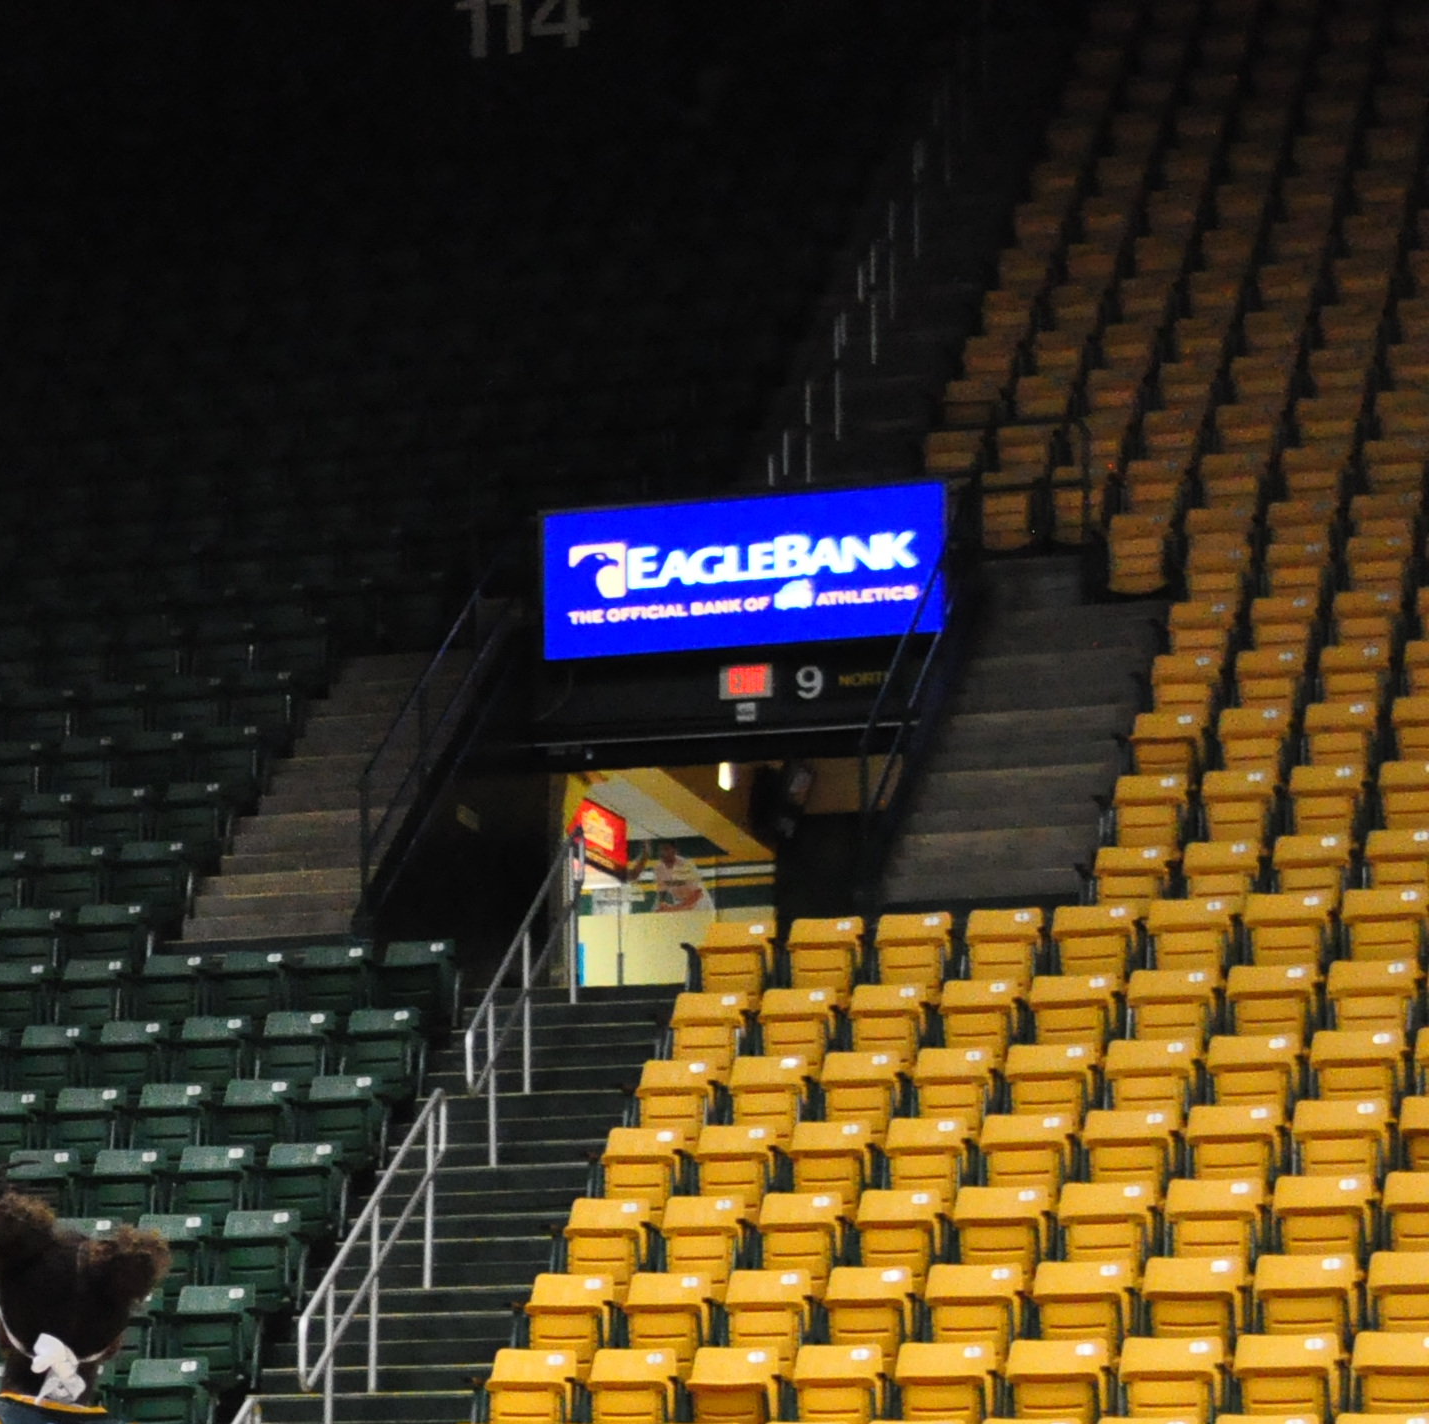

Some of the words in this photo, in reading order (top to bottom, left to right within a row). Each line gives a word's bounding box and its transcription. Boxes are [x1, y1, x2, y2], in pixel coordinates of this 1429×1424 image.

[627, 530, 919, 589] EAGLEBANK
[569, 610, 604, 624] THE
[606, 603, 688, 622] OFFICIAL
[691, 598, 741, 616] BANK
[744, 596, 769, 611] OF
[816, 585, 918, 606] ATHLETICS
[796, 666, 823, 699] 9
